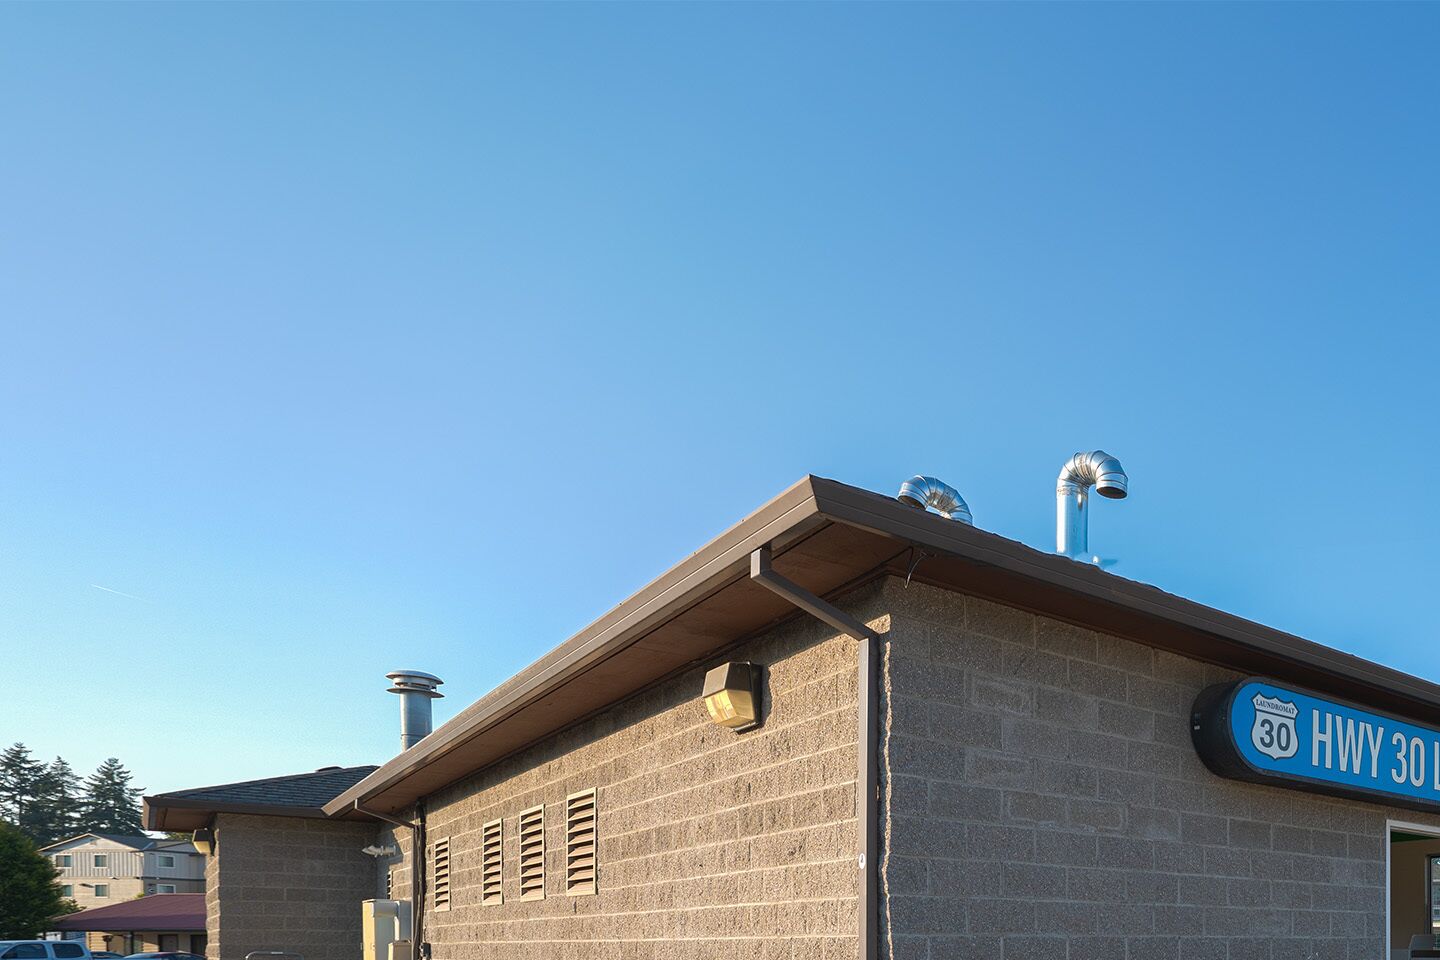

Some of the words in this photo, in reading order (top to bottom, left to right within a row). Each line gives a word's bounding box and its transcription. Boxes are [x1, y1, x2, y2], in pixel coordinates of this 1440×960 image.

[1255, 699, 1296, 715] LAUNDROMAT
[1260, 718, 1291, 752] 30
[1311, 708, 1385, 779] HWY
[1391, 732, 1426, 788] 30
